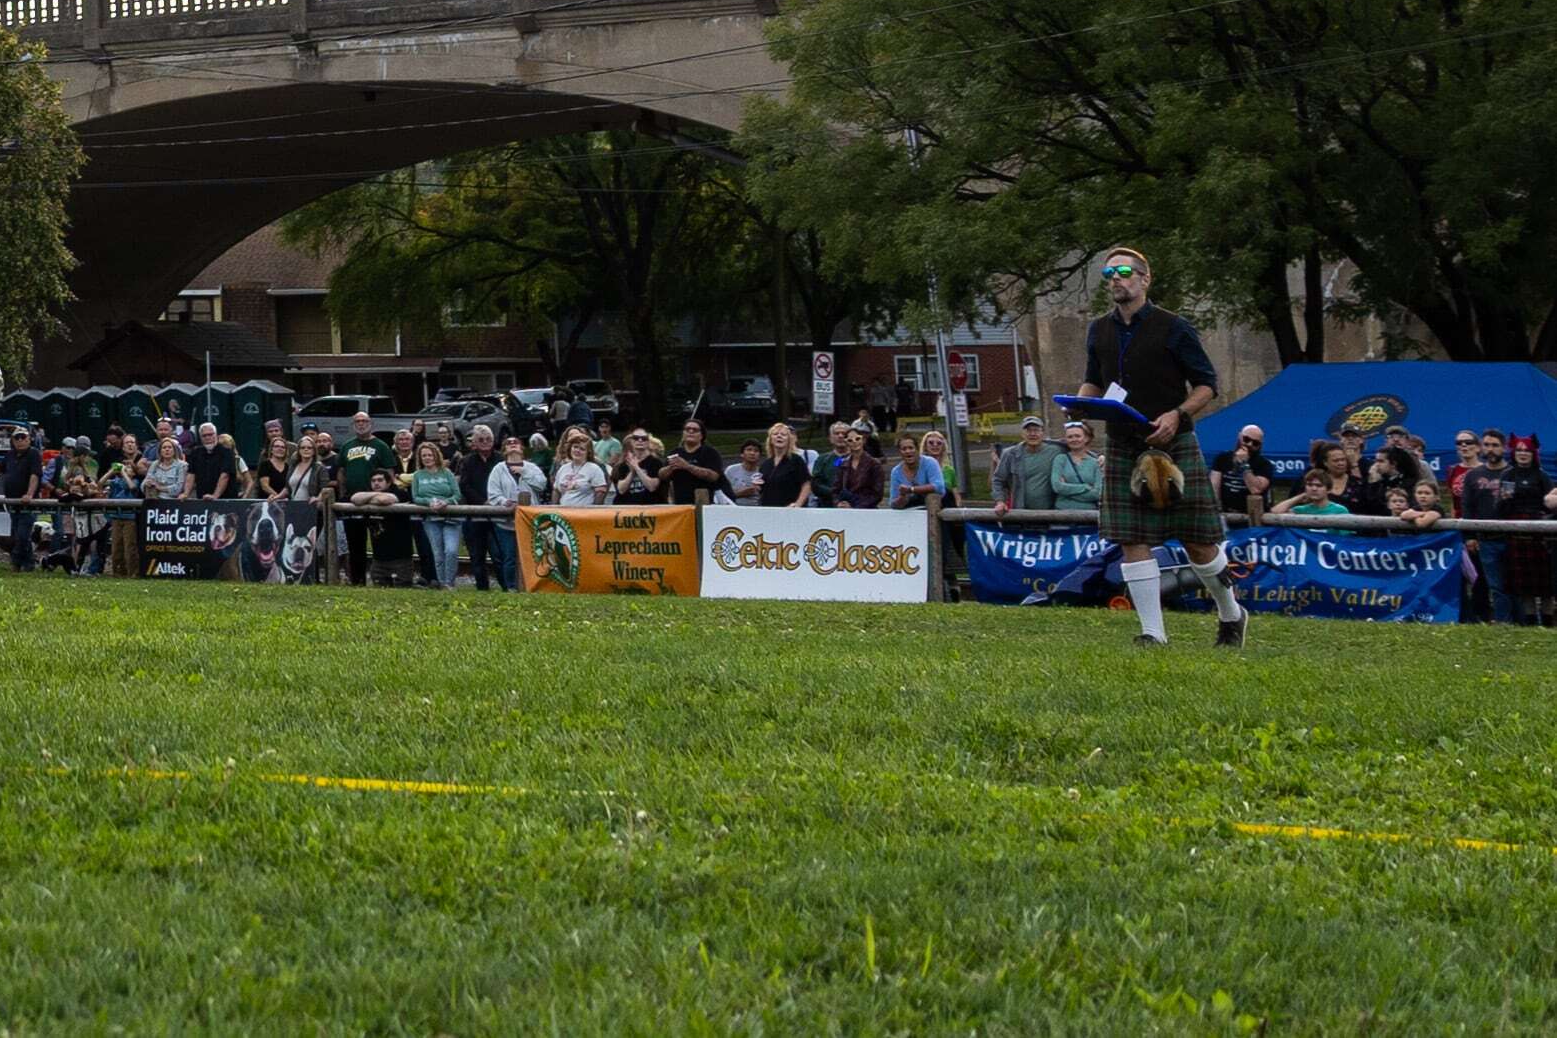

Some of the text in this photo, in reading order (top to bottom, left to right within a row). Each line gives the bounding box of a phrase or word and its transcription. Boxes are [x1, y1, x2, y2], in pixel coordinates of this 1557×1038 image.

[147, 509, 208, 525] Plaid and
[614, 512, 657, 535] Lucky
[146, 526, 207, 542] Iron Clad
[165, 545, 205, 553] TECHNOLOGY
[595, 535, 682, 560] Leprechaun
[711, 526, 920, 576] Celtic Classic
[974, 530, 1065, 567] Wright
[1229, 537, 1307, 566] edical
[1318, 540, 1419, 577] Center,
[1423, 547, 1454, 571] PC
[155, 561, 186, 575] Altek
[612, 561, 665, 585] Winery
[1253, 585, 1323, 607] Lehigh
[1331, 588, 1403, 612] Valley
